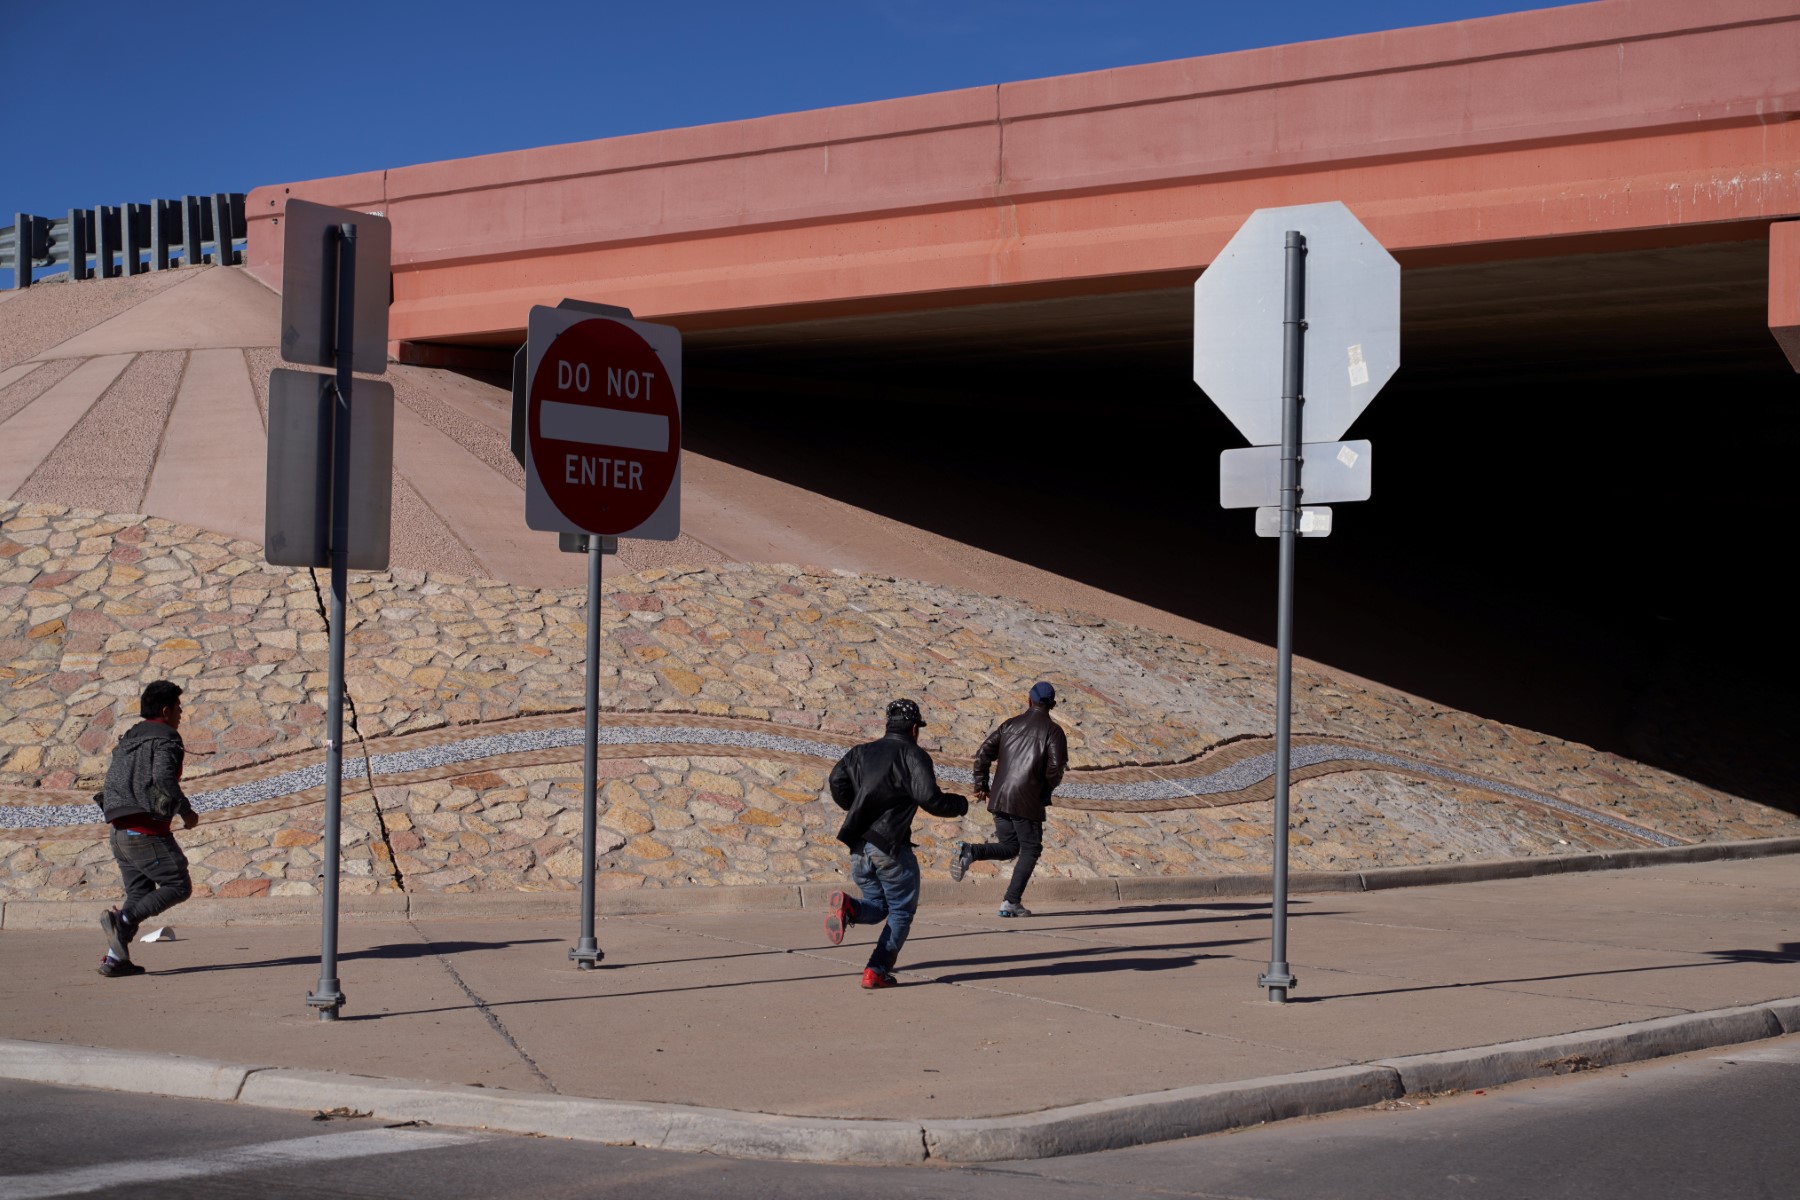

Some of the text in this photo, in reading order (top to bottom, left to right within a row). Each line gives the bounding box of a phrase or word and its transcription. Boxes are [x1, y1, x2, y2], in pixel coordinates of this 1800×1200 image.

[558, 359, 655, 400] DO NOT
[565, 454, 644, 491] ENTER
